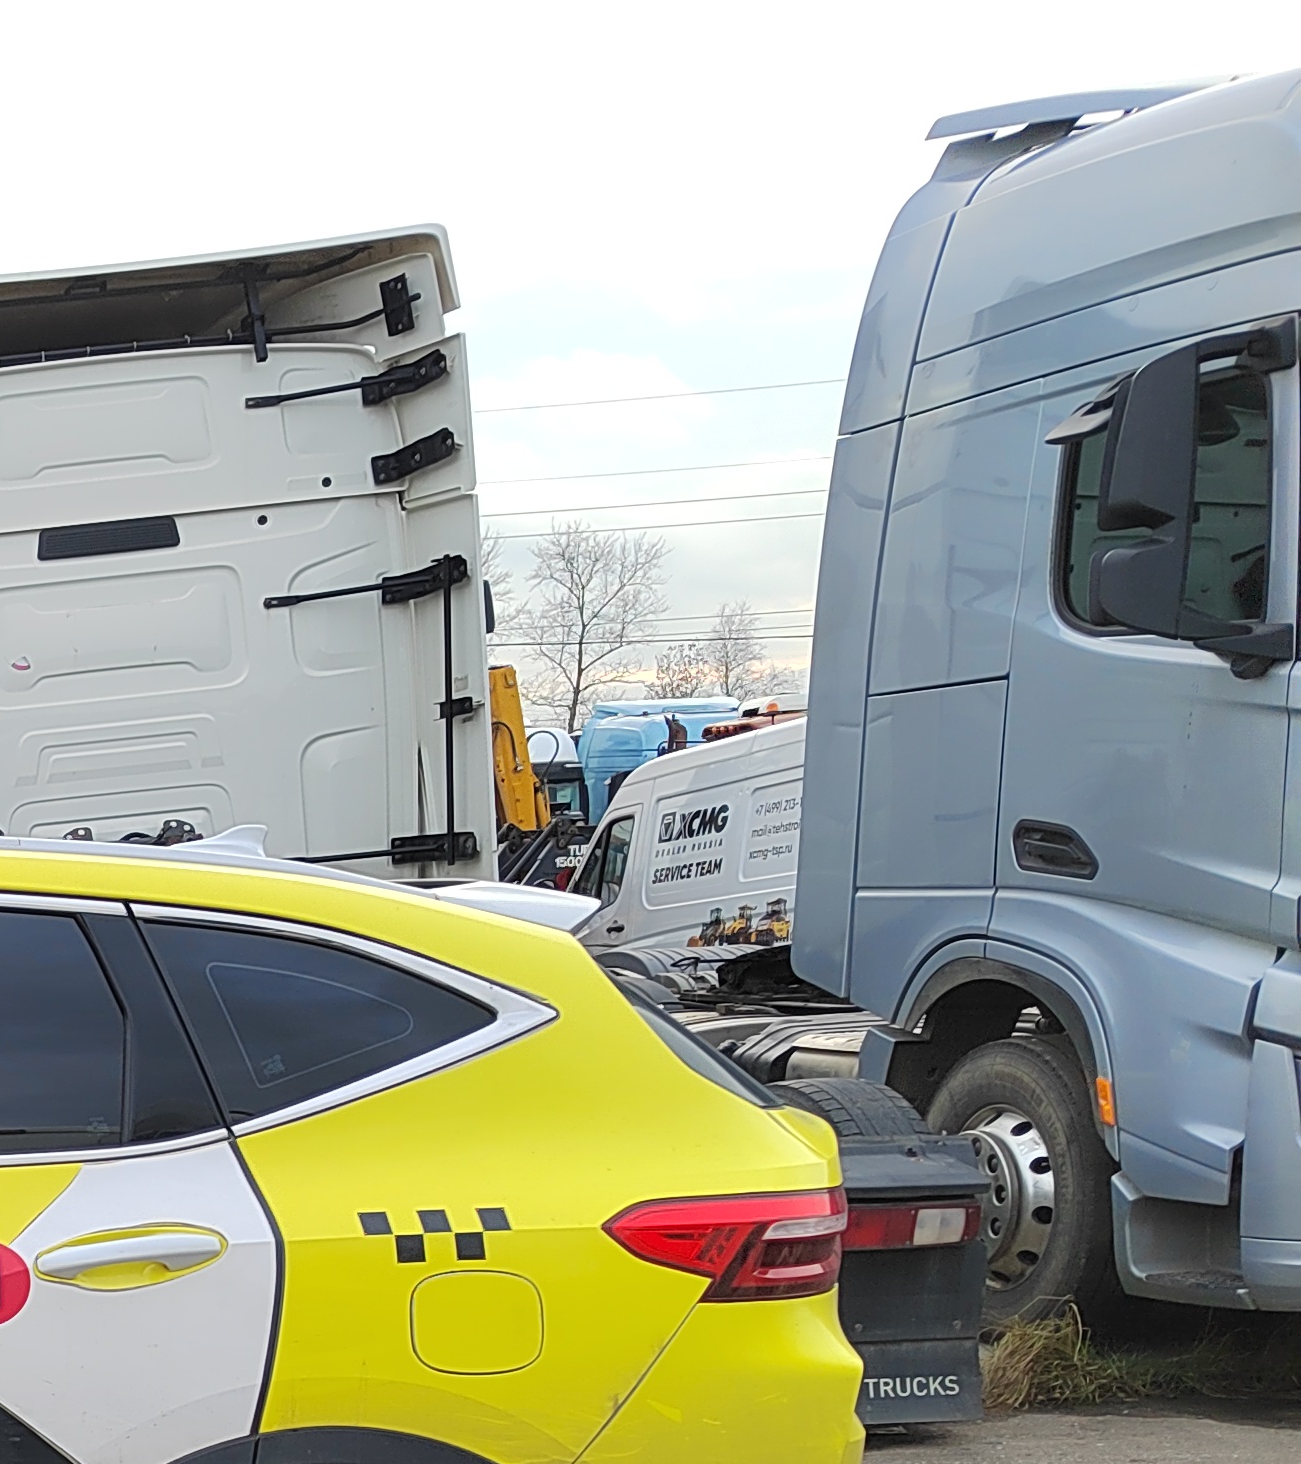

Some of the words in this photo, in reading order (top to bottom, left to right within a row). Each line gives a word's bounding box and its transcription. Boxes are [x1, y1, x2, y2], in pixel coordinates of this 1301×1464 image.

[783, 797, 802, 811] 213-
[673, 804, 730, 841] XCMG
[655, 845, 687, 859] DEALER
[691, 838, 723, 852] RUSSIA
[652, 863, 694, 884] SERVICE
[694, 857, 724, 878] TEAM
[862, 1375, 960, 1399] TRUCKS
